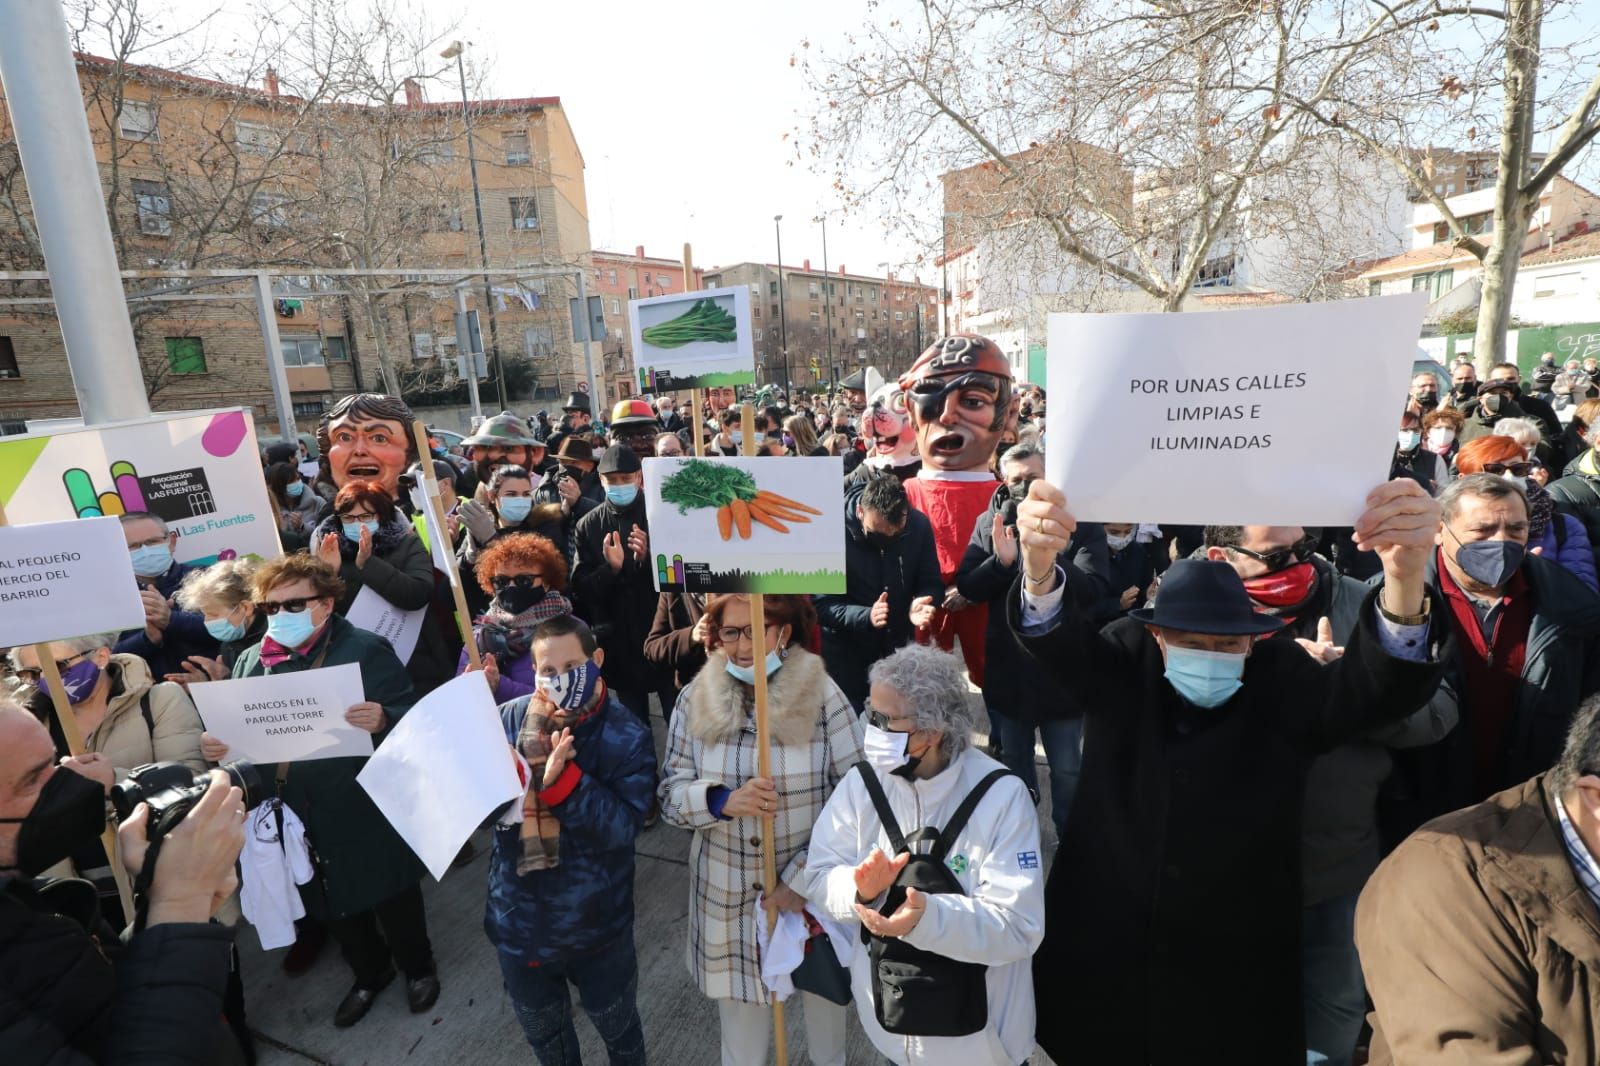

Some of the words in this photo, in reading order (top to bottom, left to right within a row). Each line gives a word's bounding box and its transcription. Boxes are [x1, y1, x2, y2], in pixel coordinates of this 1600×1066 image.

[1130, 379, 1169, 394] POR
[1175, 377, 1230, 394] UNAS
[1236, 372, 1307, 392] CALLES
[1166, 405, 1244, 422] LIMPIAS
[1250, 404, 1262, 419] E
[1151, 434, 1272, 450] ILUMINADAS
[151, 471, 193, 485] Asociación
[160, 479, 189, 490] Vecinal
[148, 490, 166, 500] LAS
[166, 483, 204, 497] FUENTES
[181, 525, 206, 536] Las
[206, 512, 256, 531] Fuentes
[17, 552, 81, 567] PEQUEÑO
[45, 570, 70, 580] DEL
[0, 588, 50, 602] BARRIO
[243, 700, 288, 712] BANCOS
[289, 698, 304, 707] EN
[306, 697, 319, 706] EL
[245, 713, 289, 725] PARQUE
[290, 710, 325, 721] TORRE
[265, 724, 314, 736] RAMONA
